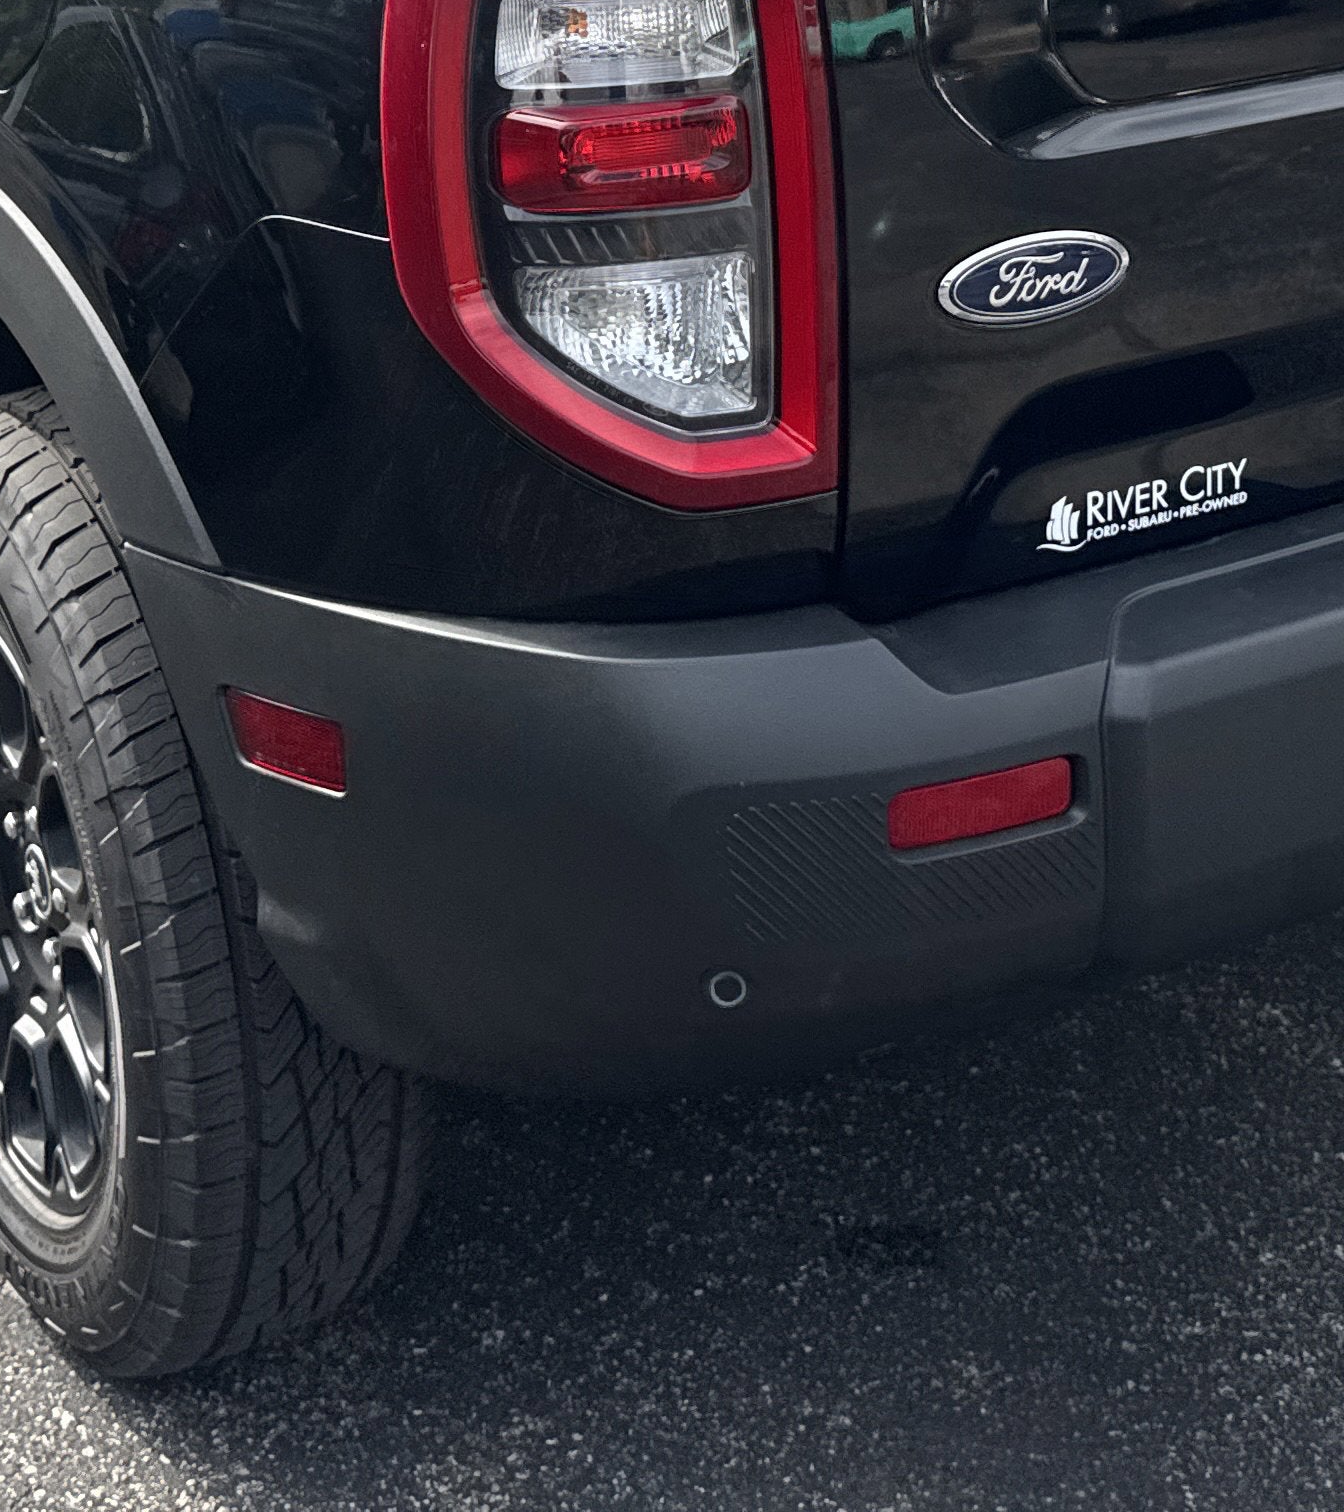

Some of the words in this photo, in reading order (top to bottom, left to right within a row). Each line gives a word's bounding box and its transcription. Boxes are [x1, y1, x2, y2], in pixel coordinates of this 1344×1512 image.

[988, 251, 1090, 308] Ford
[1085, 478, 1169, 527] RIVER
[1179, 457, 1248, 503] CITY
[1085, 522, 1120, 542] FORD
[1127, 509, 1173, 532] SUBARU
[1179, 490, 1249, 520] PRE-OWNED
